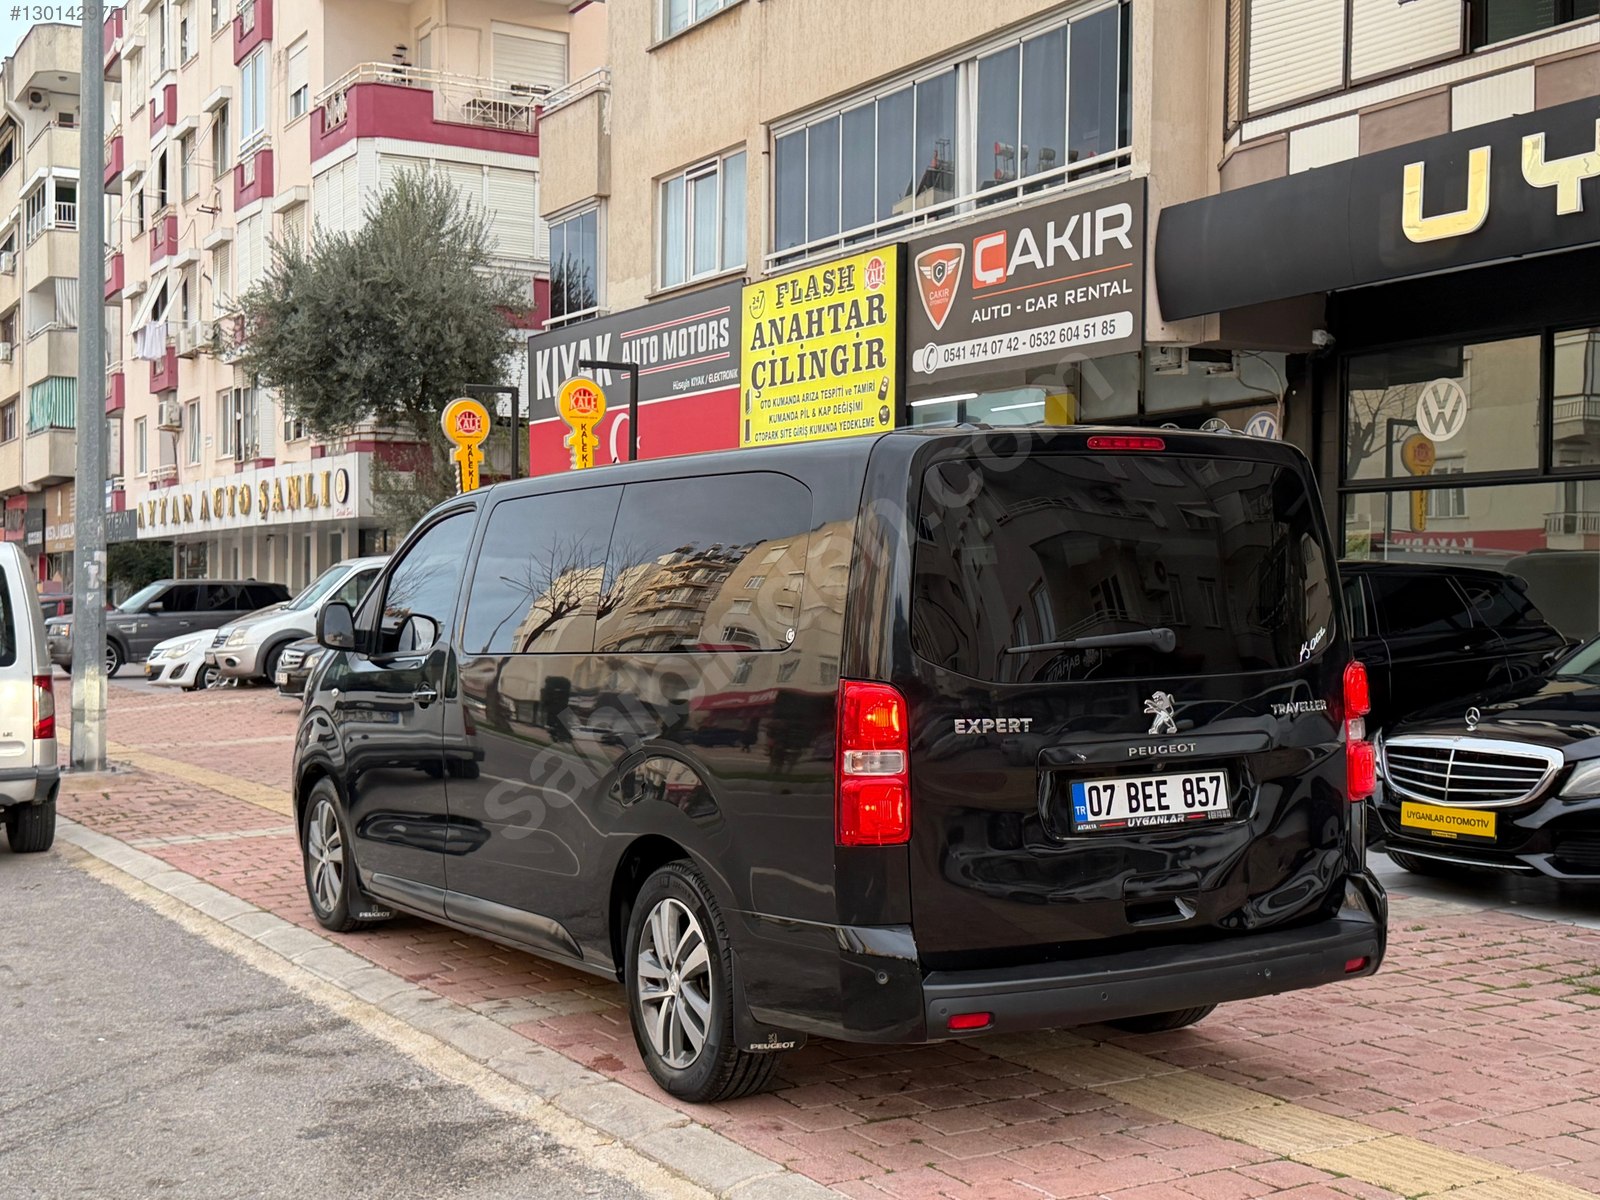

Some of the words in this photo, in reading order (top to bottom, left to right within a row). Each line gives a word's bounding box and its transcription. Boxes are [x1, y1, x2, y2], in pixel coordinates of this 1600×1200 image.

[974, 203, 1133, 284] ÇAKIR
[775, 264, 855, 309] FLASH
[971, 303, 1011, 323] AUTO
[1025, 293, 1058, 313] CAR
[1064, 279, 1133, 305] RENTAL
[750, 293, 887, 351] ANAHTAR
[943, 347, 966, 363] 0541
[970, 342, 988, 358] 474
[991, 340, 1003, 354] 07
[1006, 337, 1019, 352] 42
[1029, 331, 1056, 349] 0532
[1059, 325, 1079, 342] 604
[1083, 322, 1096, 338] 51
[1101, 319, 1116, 336] 85
[536, 333, 612, 400] KIYAK
[621, 334, 659, 365] AUTO
[662, 317, 730, 361] MOTORS
[751, 332, 887, 398] ÇİLİNGİR
[569, 394, 598, 412] KALE
[760, 399, 771, 409] OTO
[772, 394, 800, 407] KUMANDA
[801, 391, 819, 403] ARIZA
[821, 385, 844, 399] TESPİTİ
[845, 387, 852, 396] ve
[853, 379, 876, 394] TAMİRİ
[455, 416, 482, 432] KALE
[769, 410, 799, 424] KUMANDA
[800, 408, 810, 419] PİL
[811, 407, 816, 417] &
[818, 405, 831, 416] KAP
[833, 399, 863, 415] DEĞİŞİMİ
[755, 430, 779, 442] OTOPARK
[809, 422, 837, 435] KUMANDA
[839, 416, 875, 431] YEDEKLEME
[137, 494, 192, 529] AYTAR
[199, 482, 252, 522] AUTO
[1271, 699, 1328, 717] TRAVELLER
[954, 717, 1033, 735] EXPERT
[1128, 742, 1197, 757] PEUGEOT
[1075, 805, 1086, 816] TR
[1088, 783, 1116, 817] 07
[1126, 779, 1170, 814] BEE
[1182, 775, 1221, 809] 857
[1127, 814, 1185, 828] UYGANLAR
[1406, 810, 1445, 823] UYGANLAR
[750, 1041, 796, 1050] PEUGEOT
